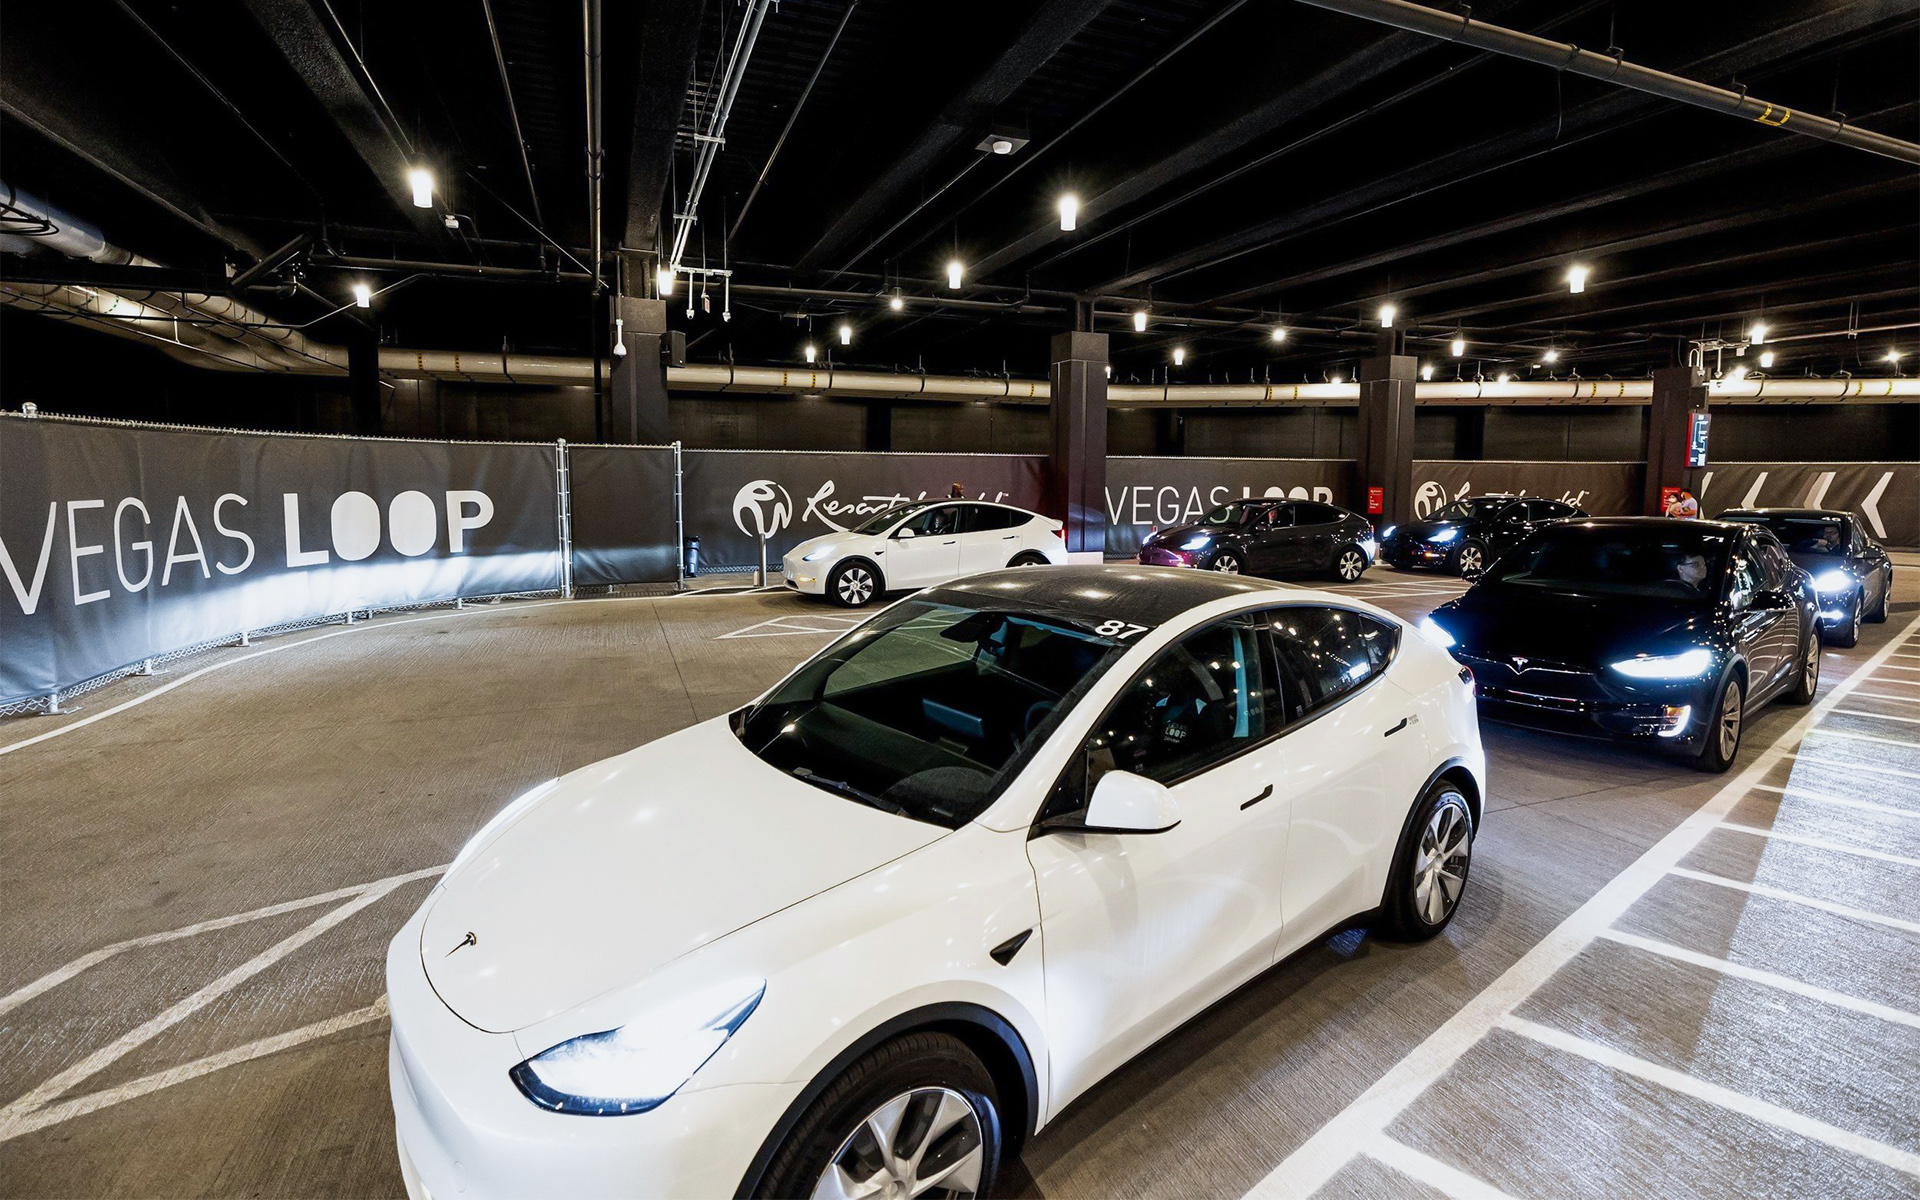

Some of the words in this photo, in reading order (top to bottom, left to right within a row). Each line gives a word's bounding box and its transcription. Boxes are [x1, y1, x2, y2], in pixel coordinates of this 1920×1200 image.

[1105, 486, 1230, 526] VEGAS
[0, 493, 256, 615] VEGAS
[284, 490, 495, 568] LOOP
[1095, 620, 1149, 639] 87
